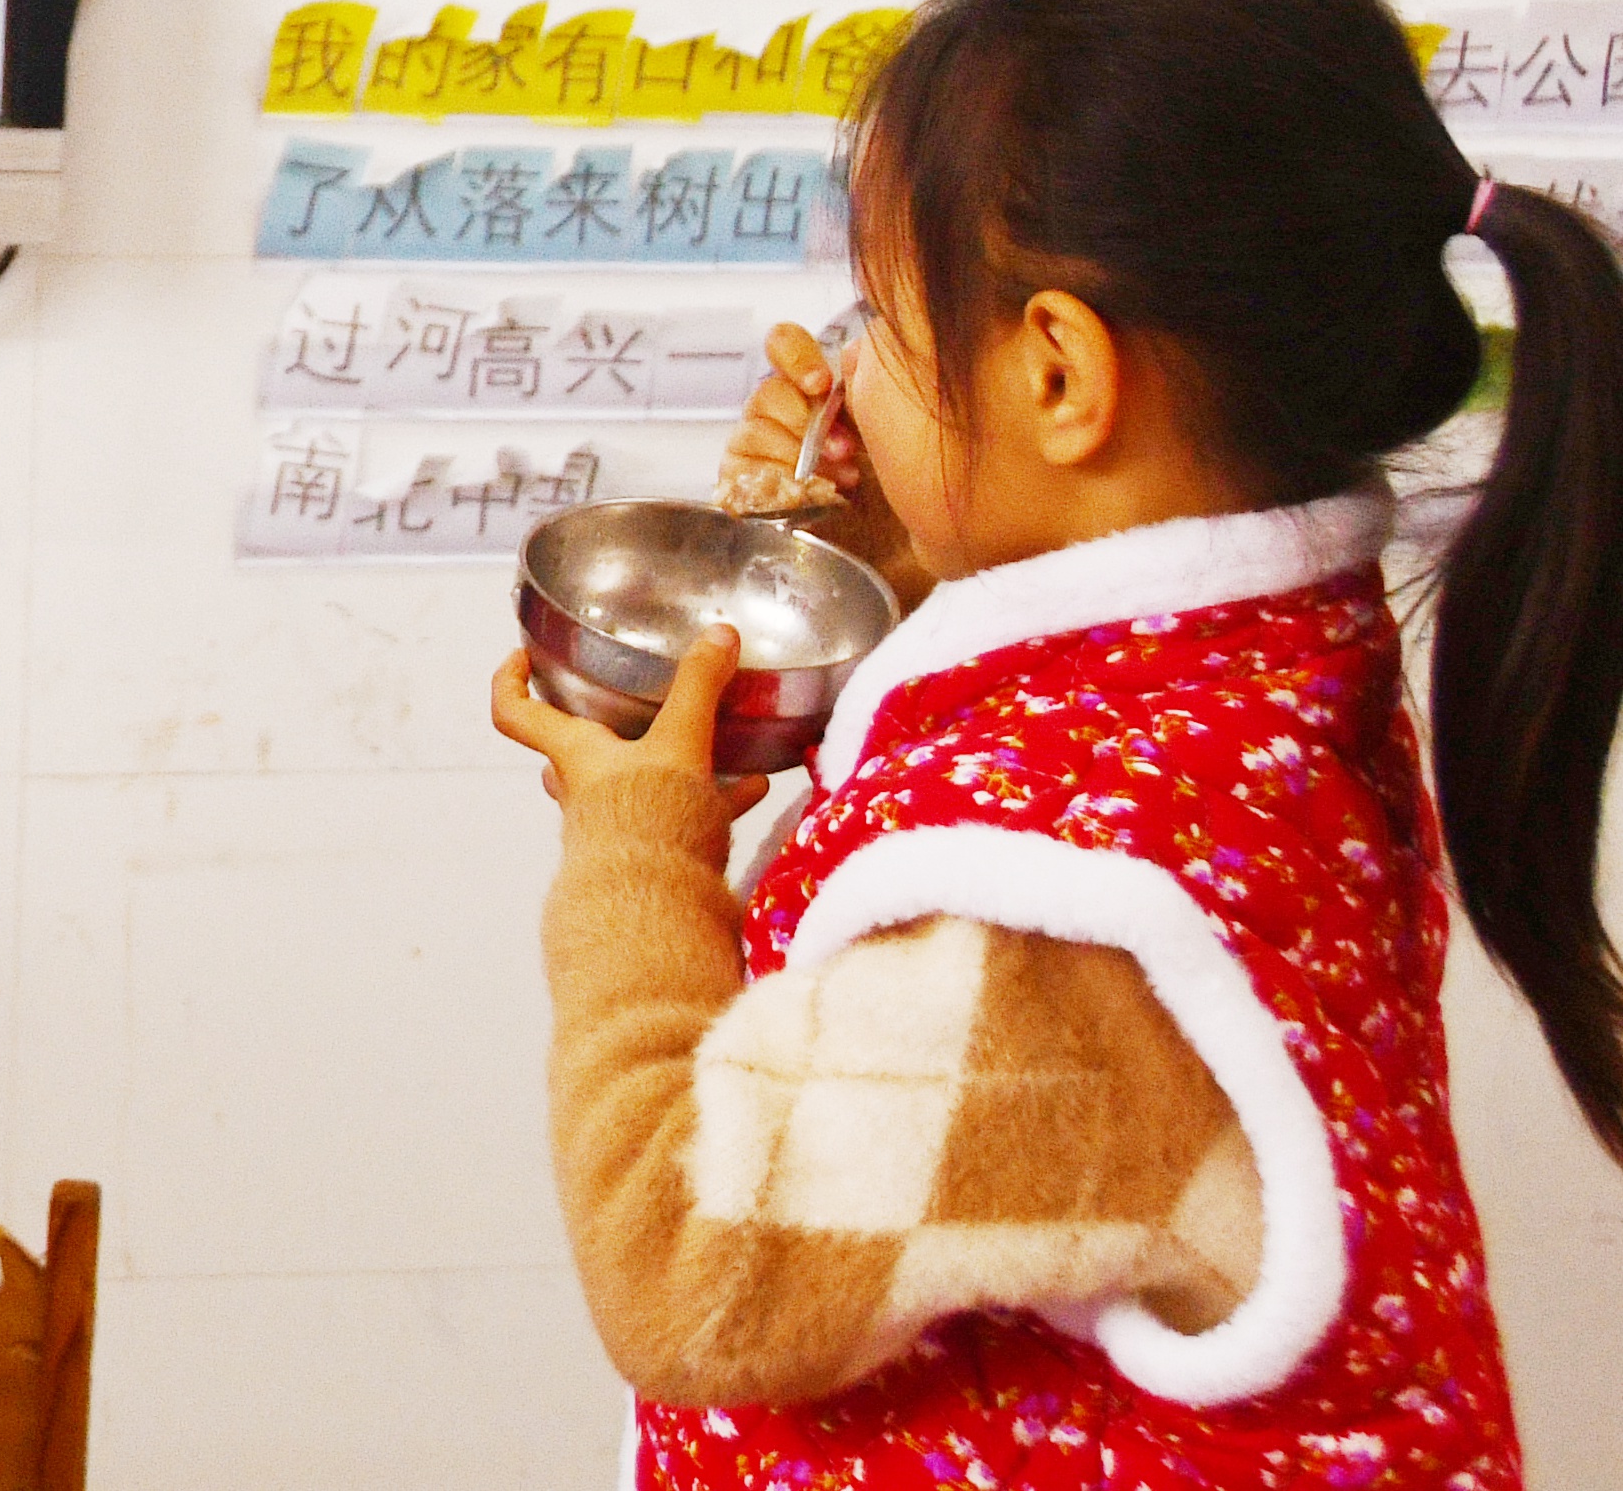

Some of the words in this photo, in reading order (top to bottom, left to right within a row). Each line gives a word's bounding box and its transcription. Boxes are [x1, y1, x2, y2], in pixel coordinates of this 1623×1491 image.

[1428, 30, 1623, 108] 去公
[283, 154, 803, 247] 了从落来树出
[285, 297, 745, 397] 过河高兴一
